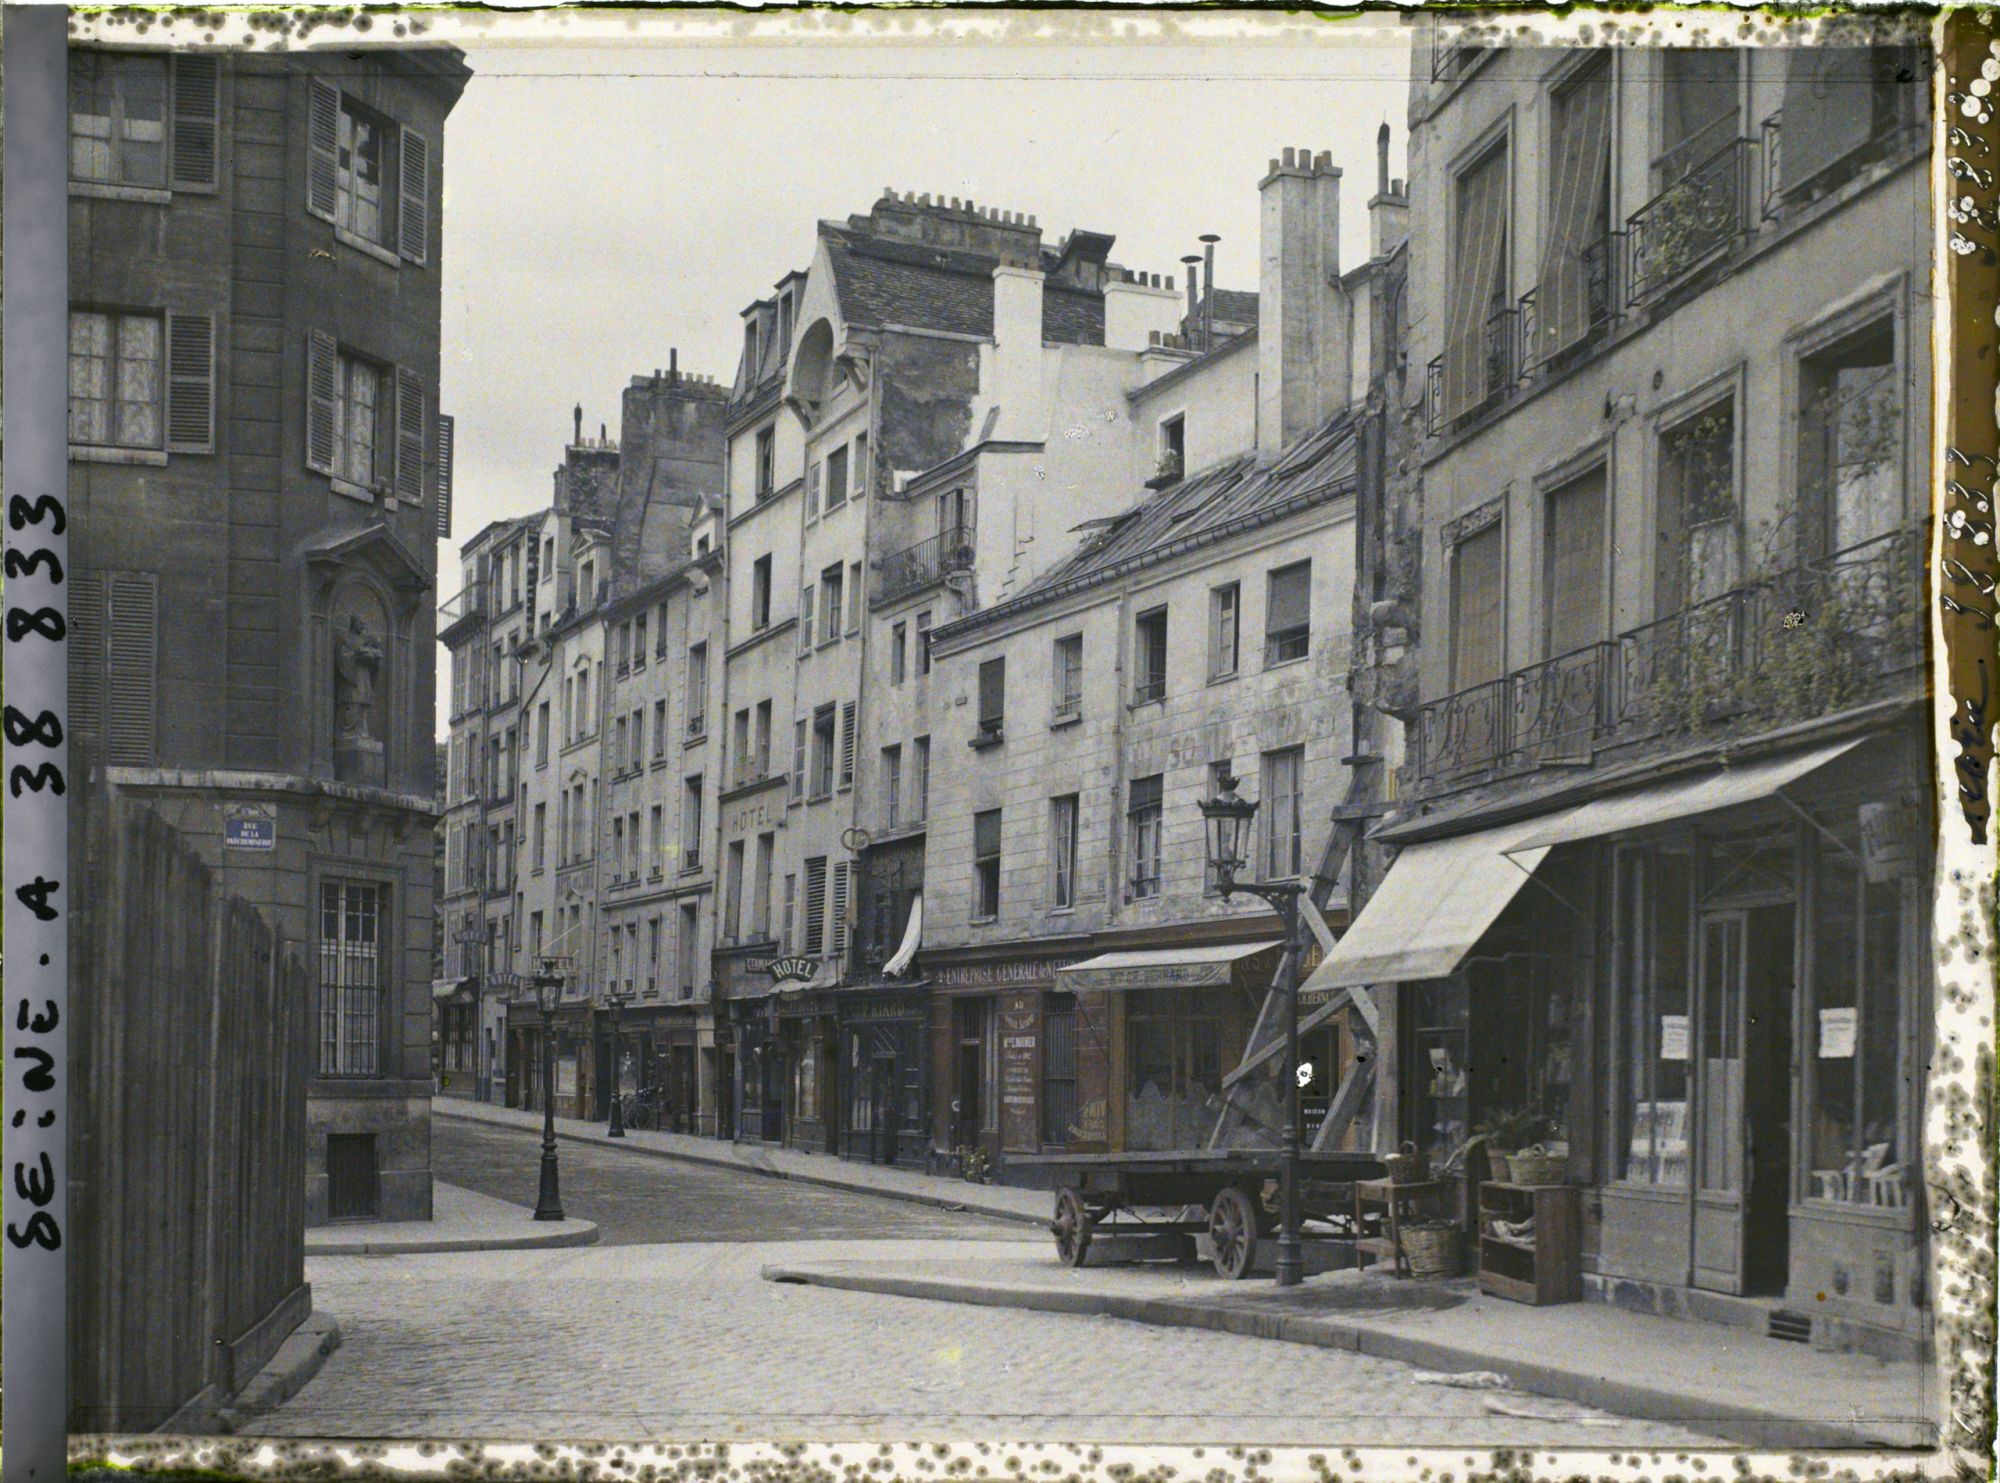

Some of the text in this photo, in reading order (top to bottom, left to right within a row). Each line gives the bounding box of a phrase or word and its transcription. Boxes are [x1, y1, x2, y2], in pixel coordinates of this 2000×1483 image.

[6, 494, 64, 643] 833
[6, 705, 64, 798] 38
[240, 830, 259, 838] DE LA
[243, 822, 257, 830] RUE
[772, 958, 813, 979] HOTEL
[946, 965, 993, 985] ENTREPRISE
